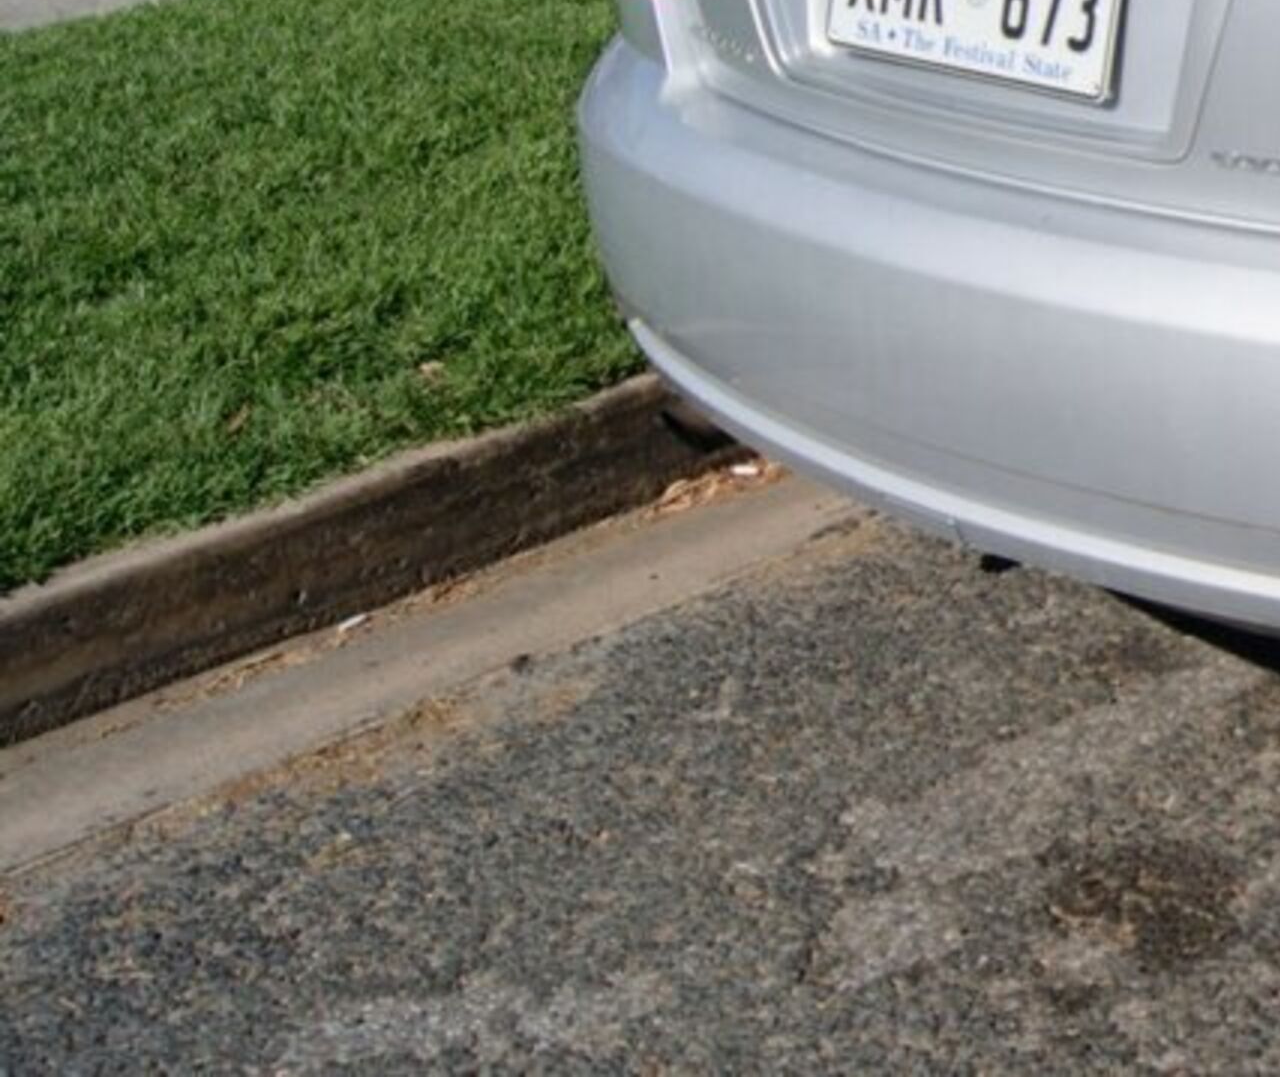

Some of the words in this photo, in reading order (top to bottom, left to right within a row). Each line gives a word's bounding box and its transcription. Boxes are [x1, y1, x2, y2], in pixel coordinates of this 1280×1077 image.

[856, 18, 881, 41] SA
[902, 28, 935, 51] The
[943, 36, 1017, 72] Festival
[1022, 53, 1075, 82] State
